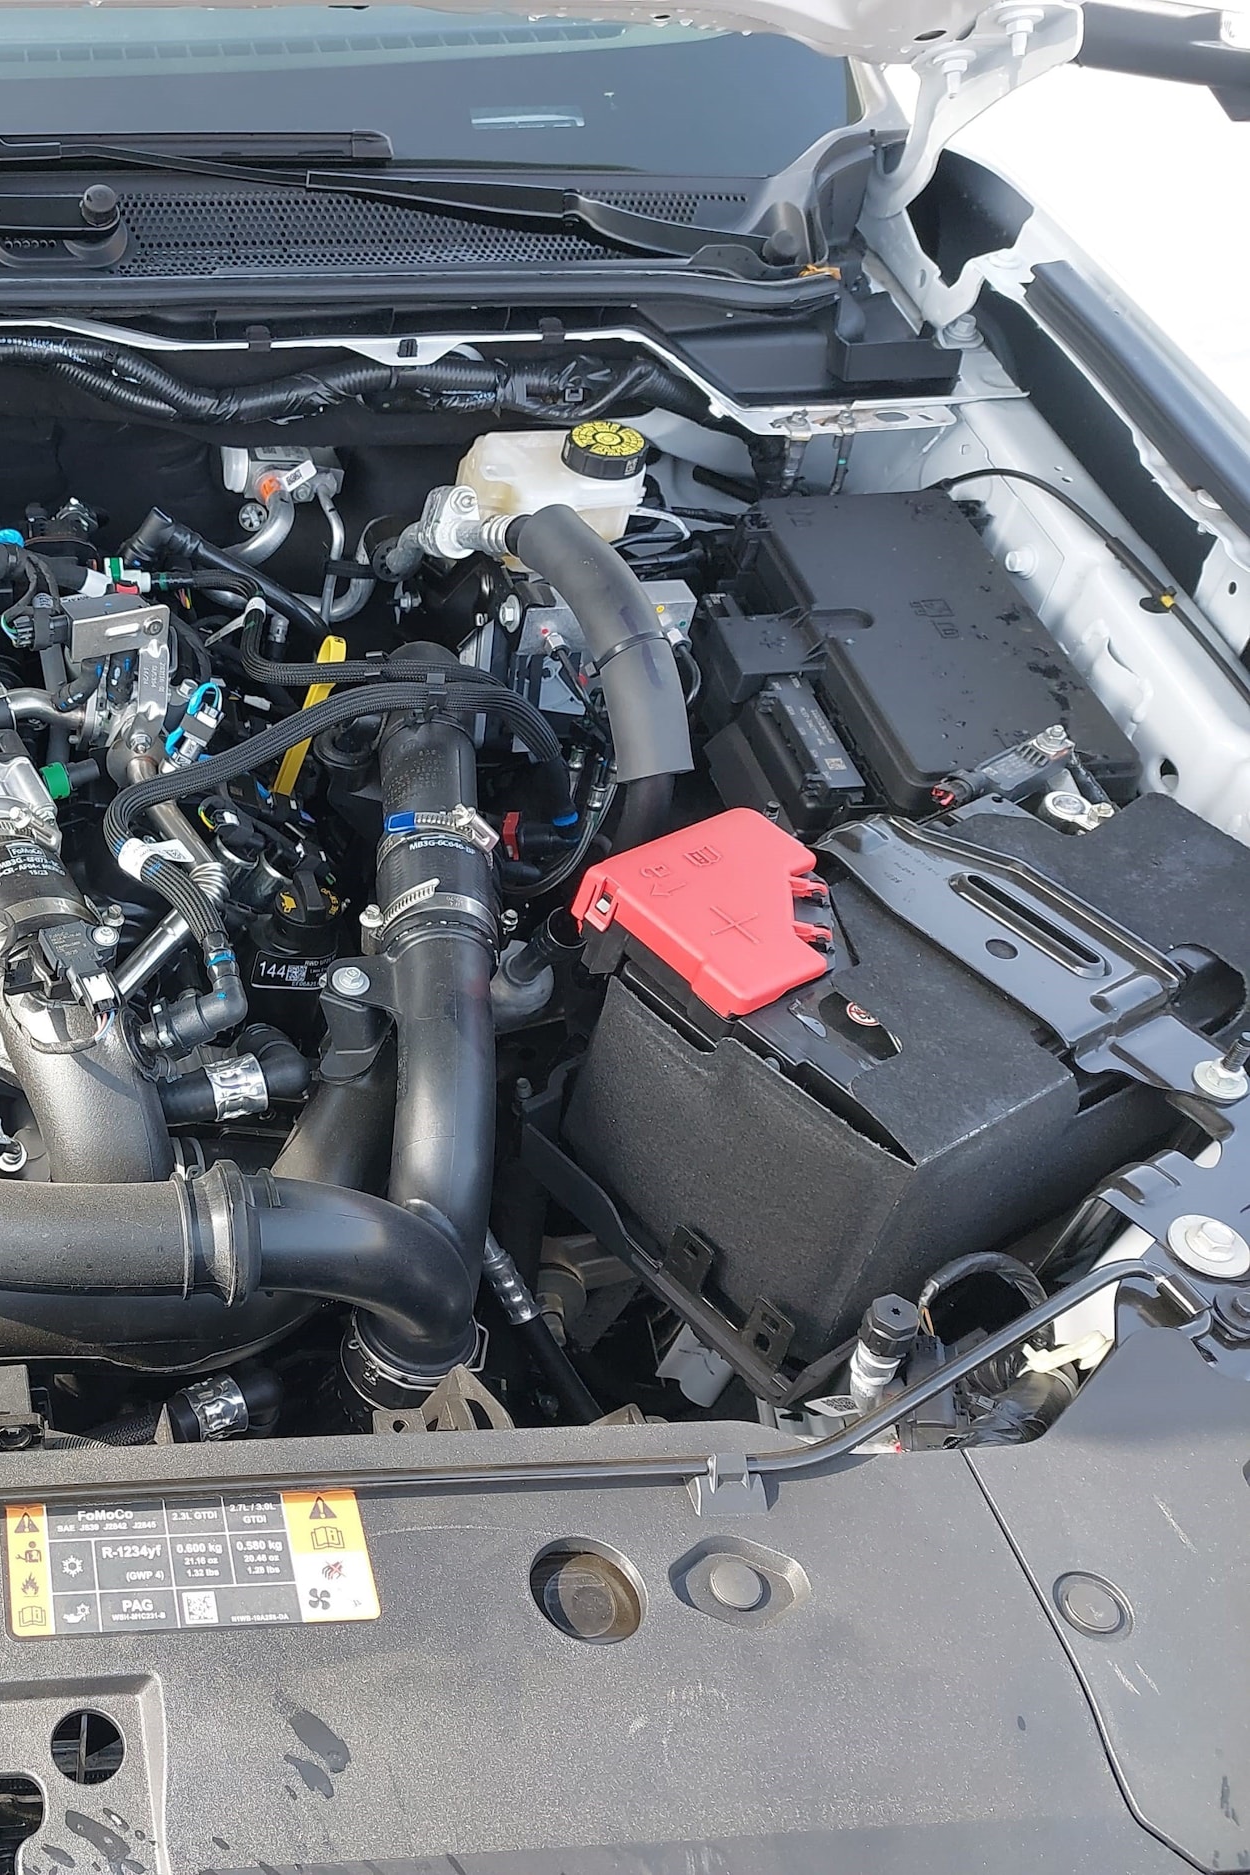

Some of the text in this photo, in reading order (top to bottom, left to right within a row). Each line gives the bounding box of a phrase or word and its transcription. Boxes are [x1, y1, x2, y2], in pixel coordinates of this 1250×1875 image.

[11, 847, 43, 856] FoMoCo
[259, 961, 286, 978] 144
[230, 1504, 250, 1512] 2.7L
[255, 1503, 276, 1511] 3.0L
[77, 1509, 134, 1521] FoMoCo
[172, 1511, 218, 1521] 2.3L GTDI
[243, 1515, 267, 1524] GTDI
[176, 1542, 223, 1554] 0.600 kg
[236, 1540, 283, 1551] 0.580 kg
[101, 1544, 162, 1560] R-1234yf
[207, 1557, 219, 1565] oz
[268, 1554, 280, 1562] oz
[186, 1568, 220, 1577] 1.32 lbs
[266, 1566, 280, 1574] lbs
[126, 1570, 165, 1583] (GWP 4)
[122, 1599, 154, 1612] PAG
